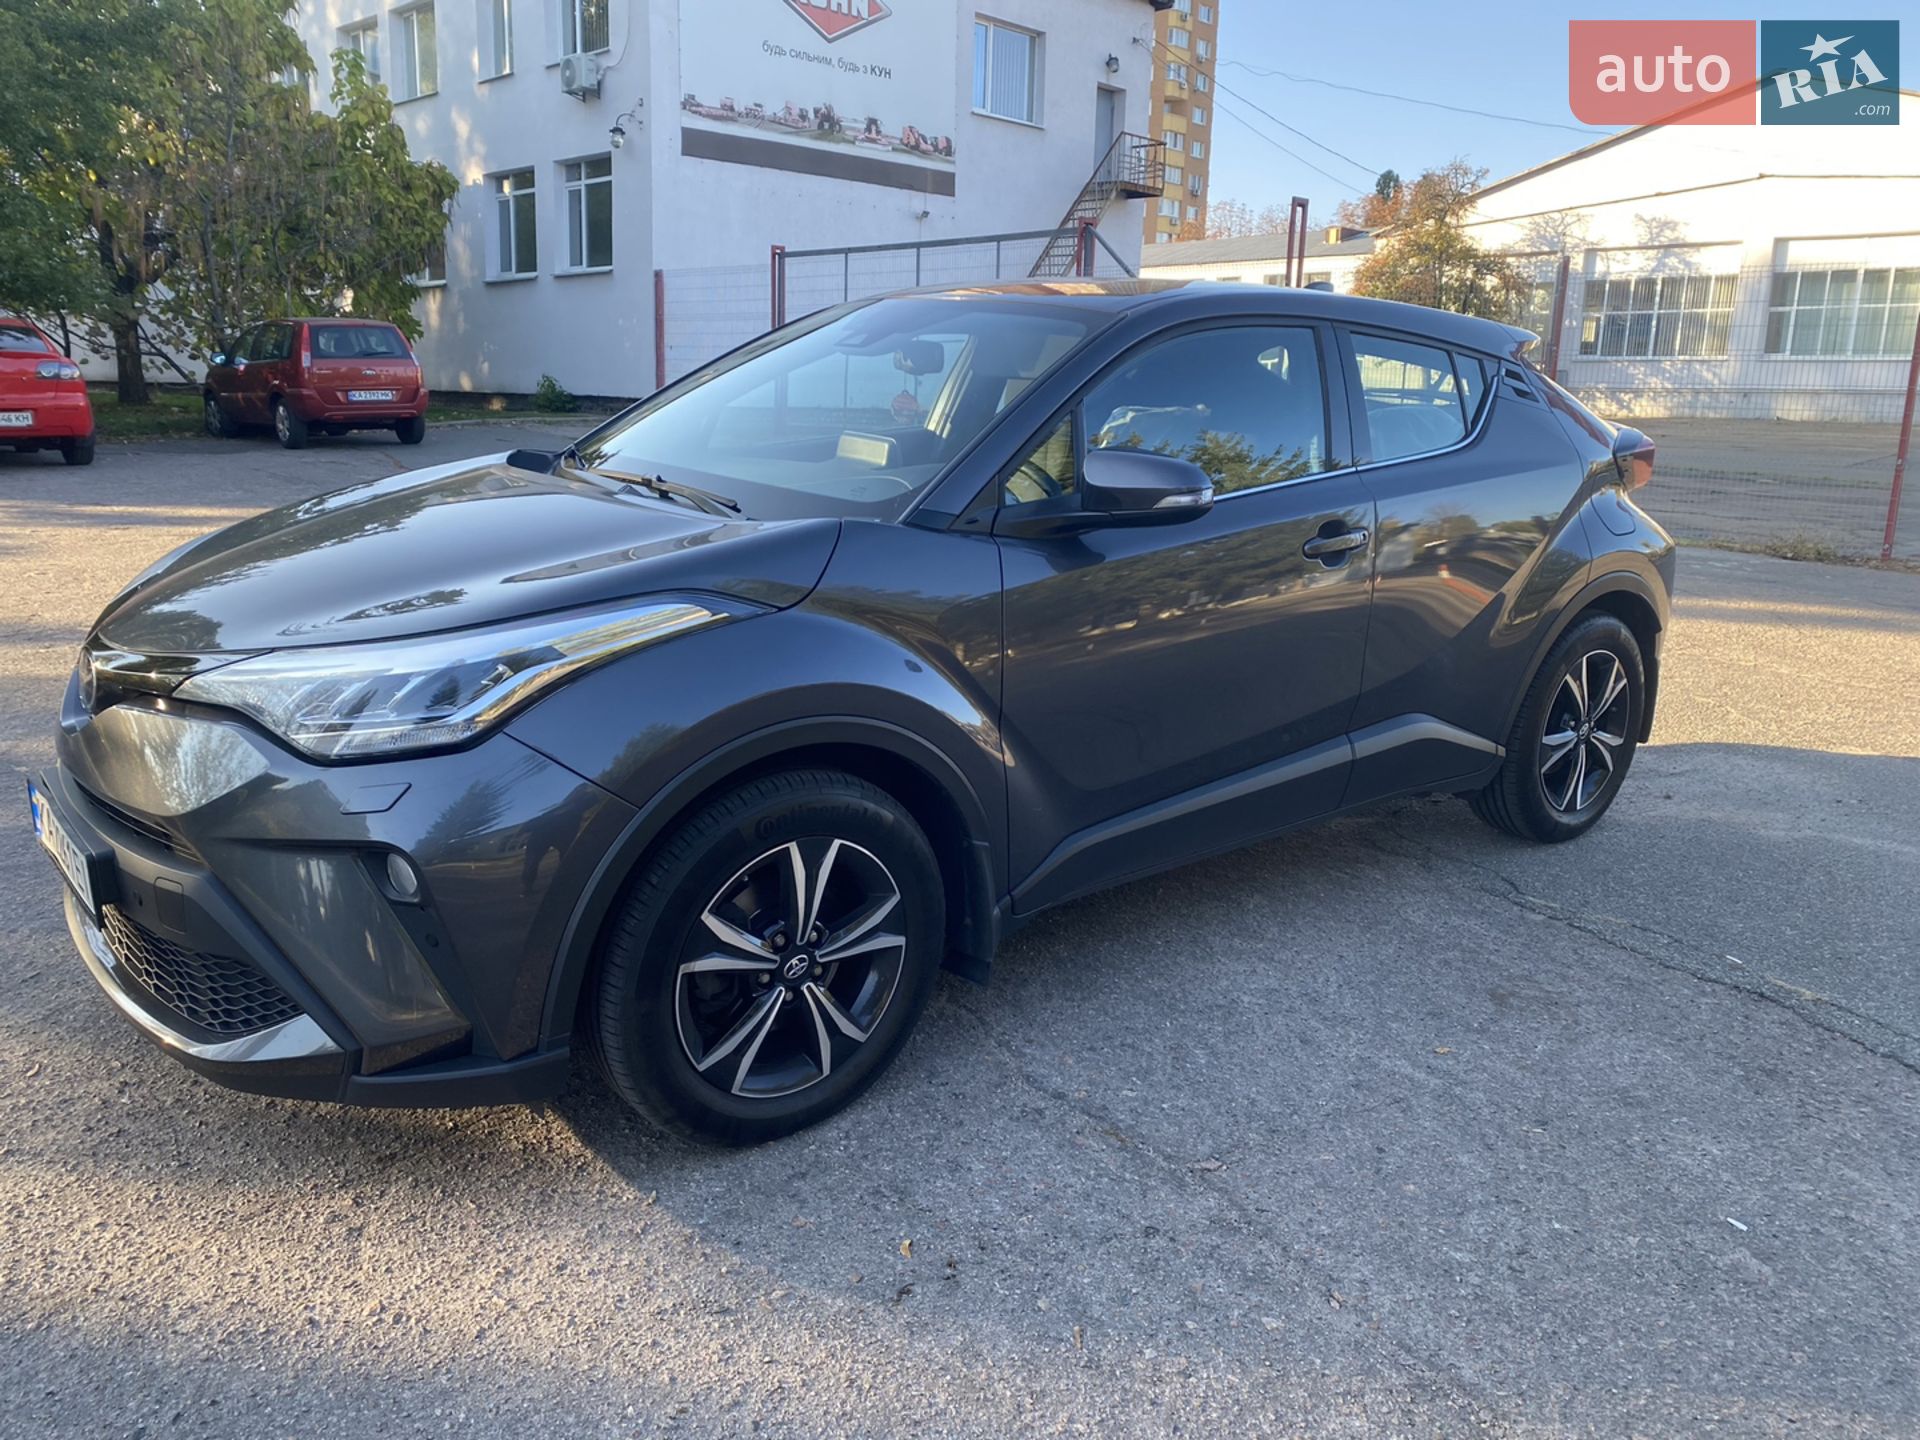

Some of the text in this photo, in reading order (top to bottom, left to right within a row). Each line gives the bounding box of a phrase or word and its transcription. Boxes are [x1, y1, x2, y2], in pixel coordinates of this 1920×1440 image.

[762, 40, 787, 57] будь
[789, 48, 835, 68] сильним,
[837, 57, 860, 73] будь
[870, 64, 892, 79] КУН
